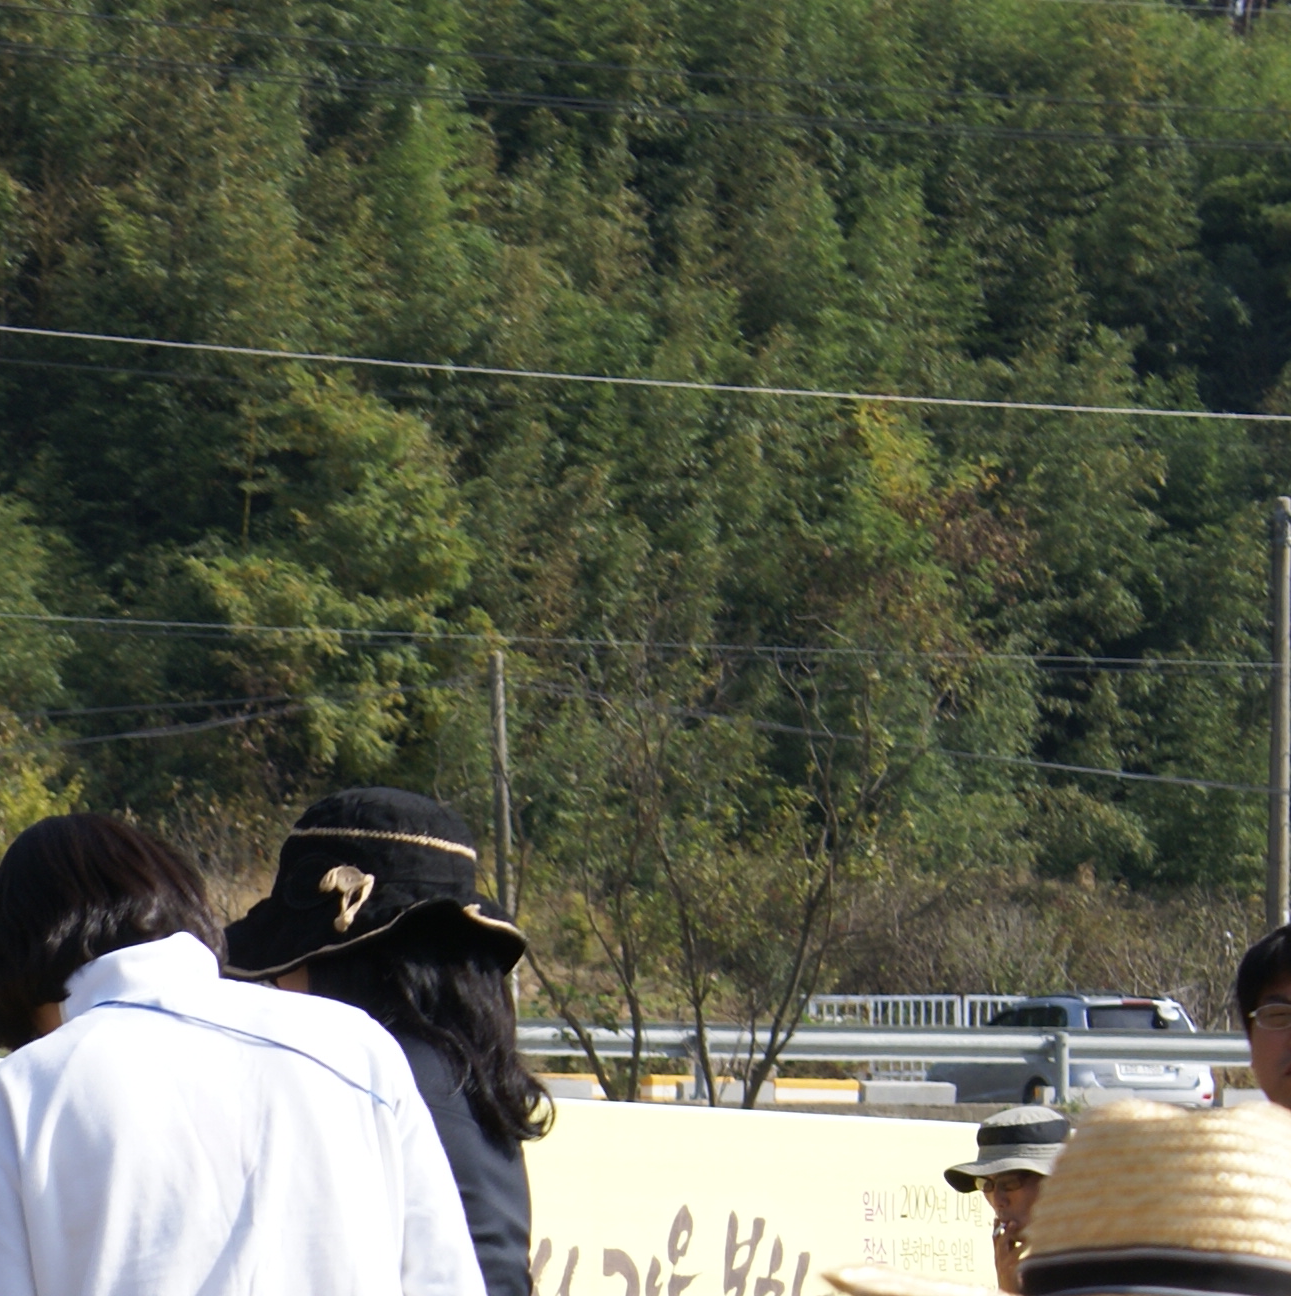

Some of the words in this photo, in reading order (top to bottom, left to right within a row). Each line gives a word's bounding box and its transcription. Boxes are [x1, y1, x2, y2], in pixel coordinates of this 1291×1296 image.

[862, 1190, 887, 1223] 일시
[899, 1184, 949, 1224] 2009년
[863, 1237, 888, 1266] 장소
[899, 1235, 949, 1272] 봉하마을
